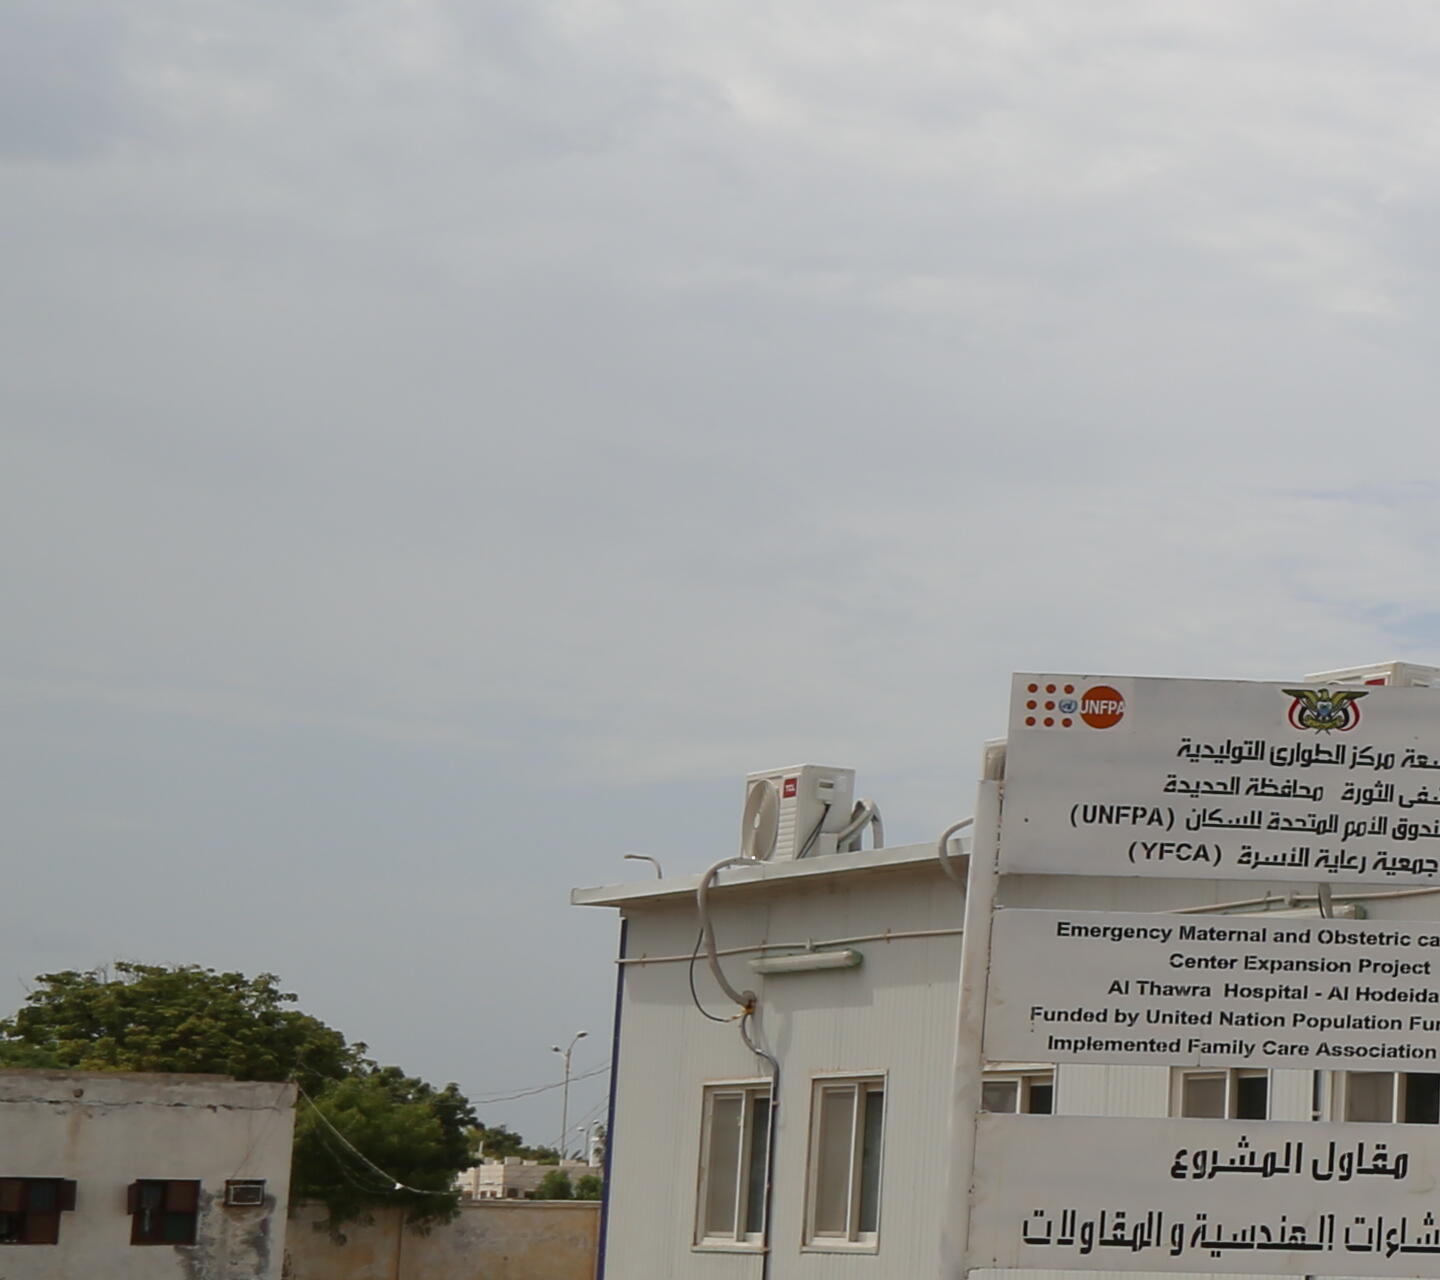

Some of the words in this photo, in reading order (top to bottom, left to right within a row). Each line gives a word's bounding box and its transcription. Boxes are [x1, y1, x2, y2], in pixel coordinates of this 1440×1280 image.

[1080, 699, 1126, 715] UNFPA
[1177, 738, 1265, 764] التوليدية
[1269, 742, 1346, 767] الطوارئ
[1349, 746, 1395, 770] مركز
[1163, 774, 1240, 798] الحديدة
[1245, 777, 1324, 802] محافظة
[1341, 780, 1395, 806] الثورة
[1070, 803, 1175, 832] (UNFPA)
[1186, 808, 1262, 831] للسكان
[1266, 812, 1339, 835] المتحدة
[1341, 816, 1388, 842] الأمم
[1128, 840, 1222, 867] (YFCA)
[1237, 845, 1310, 870] الأسرة
[1314, 848, 1366, 874] رعاية
[1372, 851, 1438, 877] جمعية
[1056, 921, 1172, 943] Emergency
[1179, 925, 1267, 943] Maternal
[1273, 929, 1311, 944] and
[1317, 929, 1411, 947] Obstetric
[1169, 953, 1238, 969] Center
[1244, 955, 1351, 974] Expansion
[1358, 958, 1431, 978] Project
[1107, 980, 1129, 995] Al
[1136, 980, 1211, 997] Thawra
[1223, 983, 1308, 1002] Hospital
[1327, 987, 1349, 1001] Al
[1355, 987, 1440, 1004] Hodeida
[1030, 1006, 1107, 1022] Funded
[1114, 1008, 1140, 1027] by
[1146, 1009, 1212, 1025] United
[1219, 1011, 1285, 1027] Nation
[1292, 1013, 1402, 1032] Population
[1047, 1035, 1181, 1054] Implemented
[1188, 1038, 1256, 1058] Family
[1262, 1040, 1310, 1056] Care
[1315, 1041, 1437, 1060] Association
[1170, 1135, 1303, 1179] المشروع
[1312, 1142, 1408, 1180] مقاول
[1190, 1213, 1334, 1258] الهندسية
